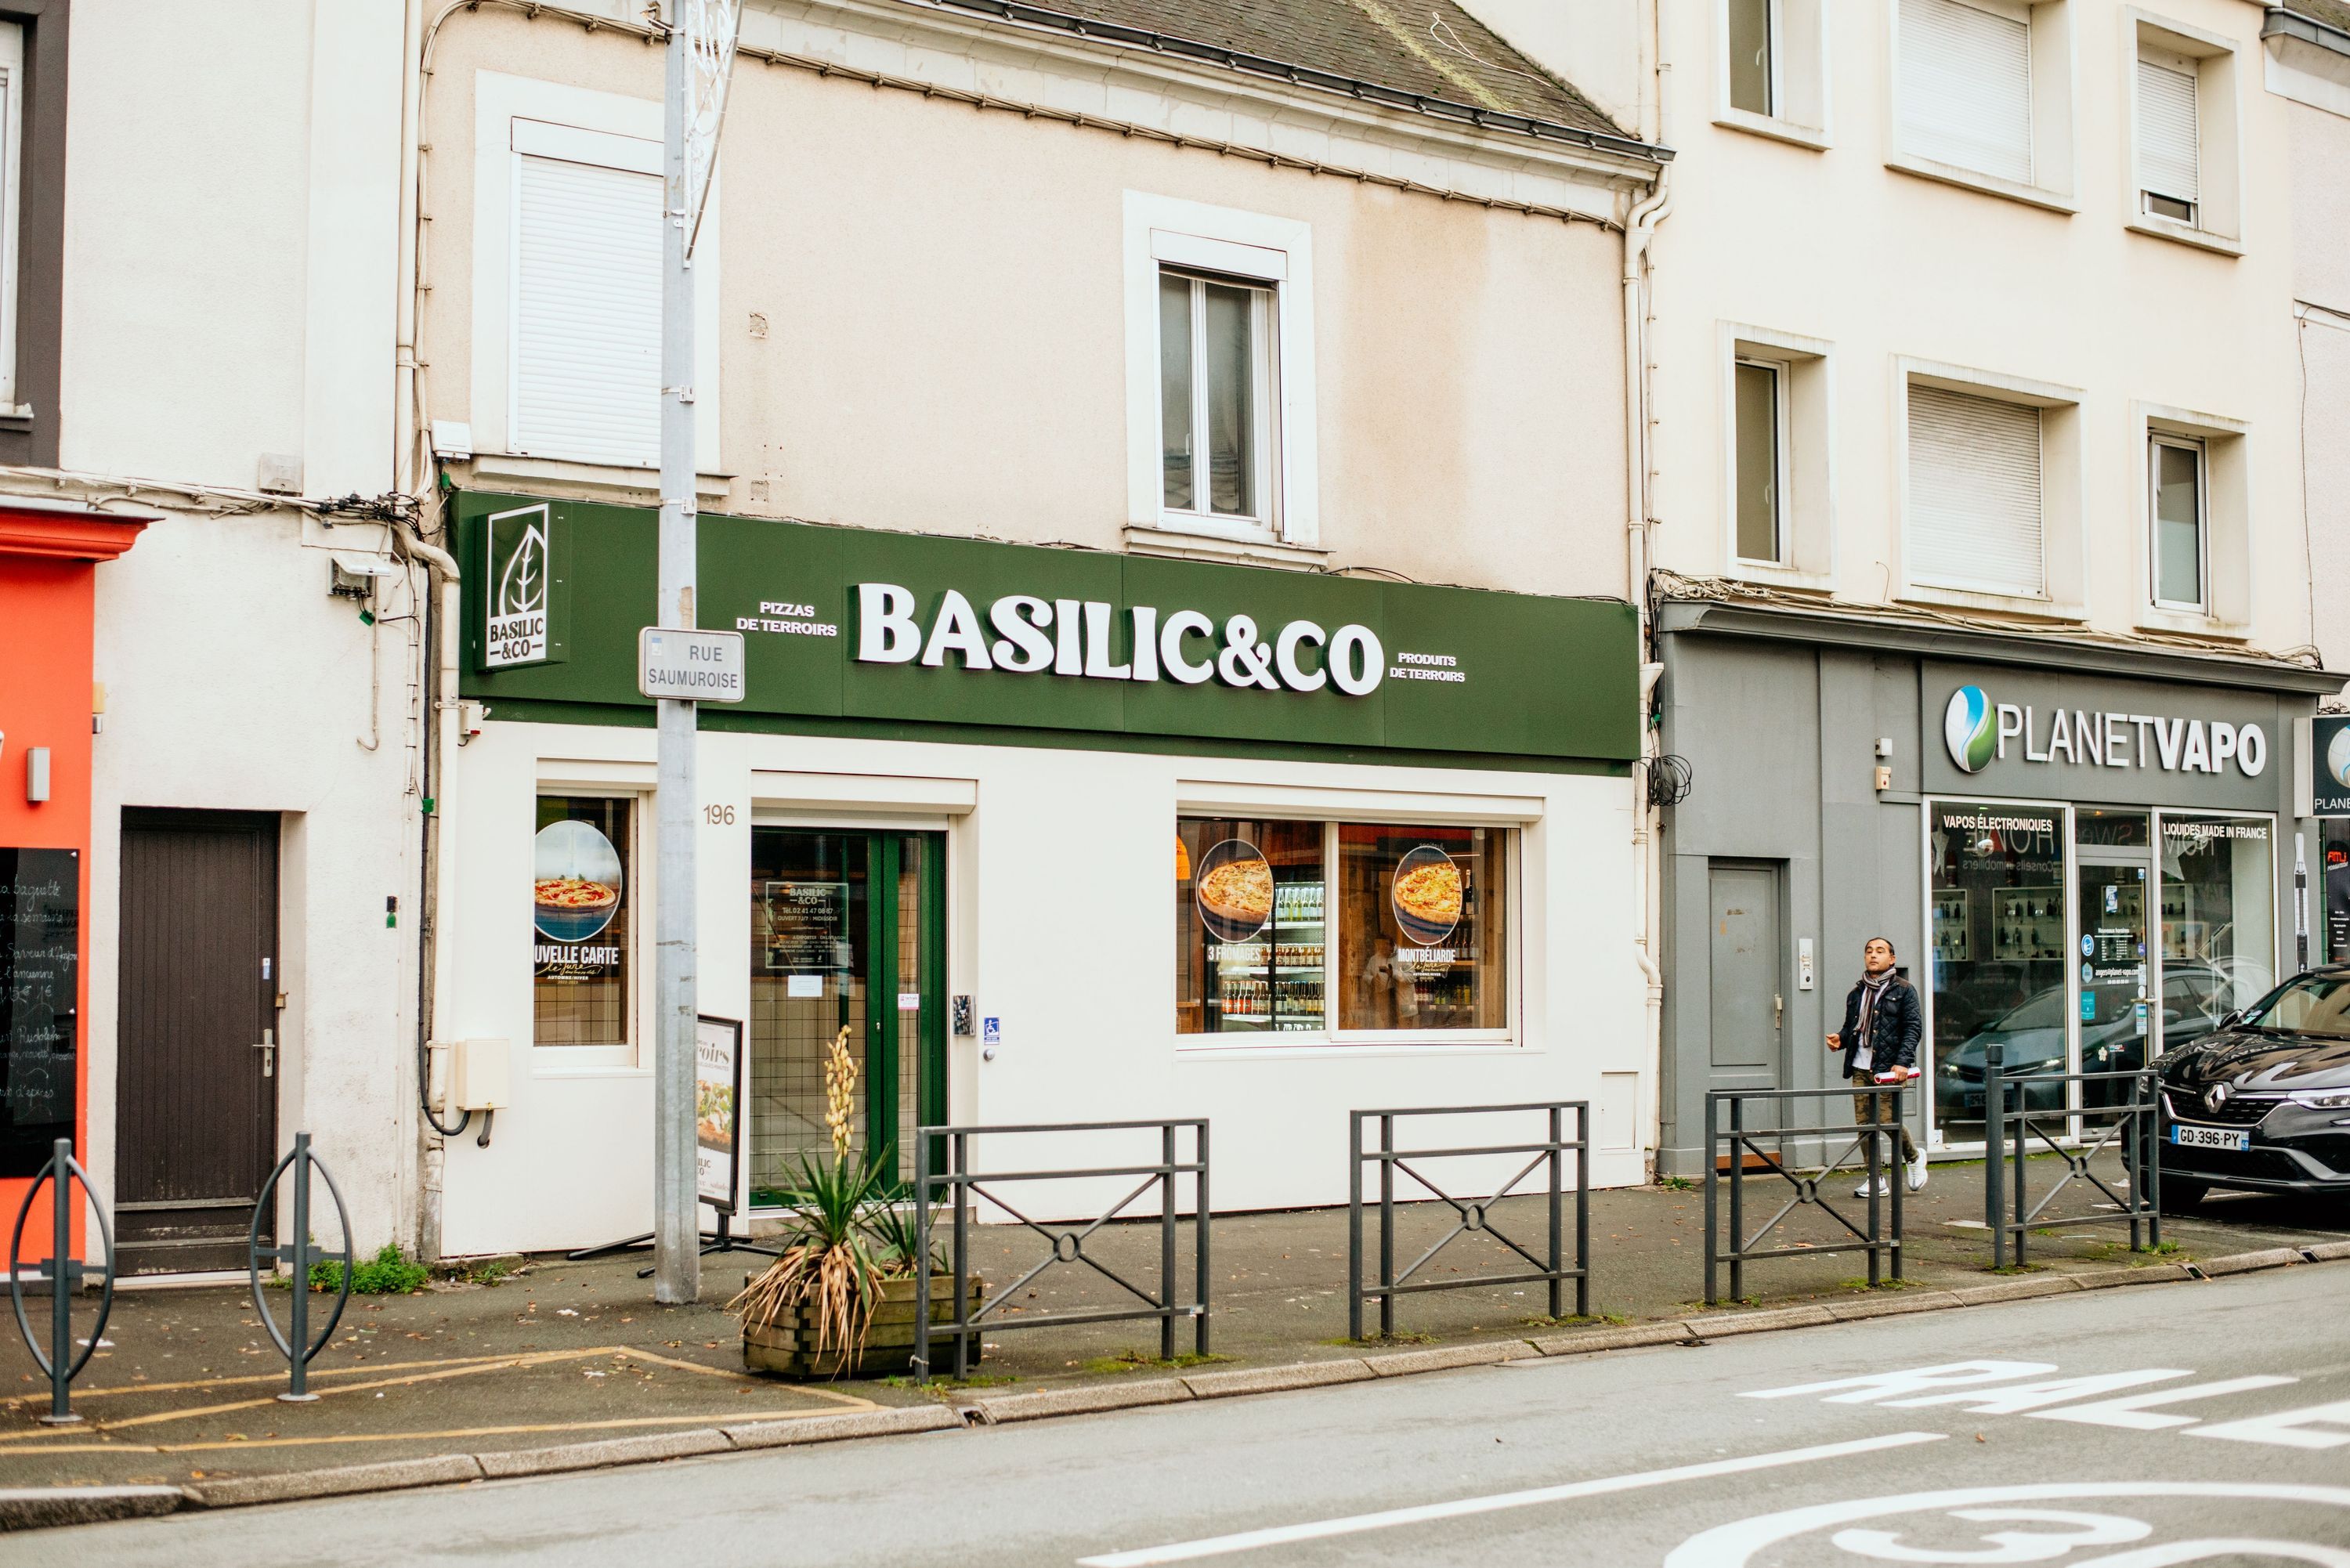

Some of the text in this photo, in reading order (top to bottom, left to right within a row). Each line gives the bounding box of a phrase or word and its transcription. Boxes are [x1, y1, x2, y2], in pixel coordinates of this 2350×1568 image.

[760, 602, 815, 618] PIZZAS
[490, 617, 544, 642] BASILIC
[736, 617, 837, 637] DE TERROIRS
[859, 583, 1385, 695] BASILIC&CO
[501, 638, 530, 659] &CO
[689, 645, 723, 662] RUE
[1397, 652, 1456, 667] PRODUITS
[649, 668, 738, 688] SAUMUROISE
[1390, 667, 1466, 682] DE TERROIRS
[1996, 703, 2267, 777] PLANETVAPO
[703, 804, 735, 826] 196
[1943, 813, 2053, 832] VAPOS ÉLECTRONIQUES
[2163, 822, 2267, 840] LIQUIDES MADE IN FRANCE
[790, 888, 826, 897] BASILIC
[580, 946, 619, 964] CARTE
[1208, 946, 1260, 961] 3 FROMAGES
[1397, 946, 1456, 963] MONTBÉLIARDE
[2180, 1129, 2240, 1147] GD-396-PY
